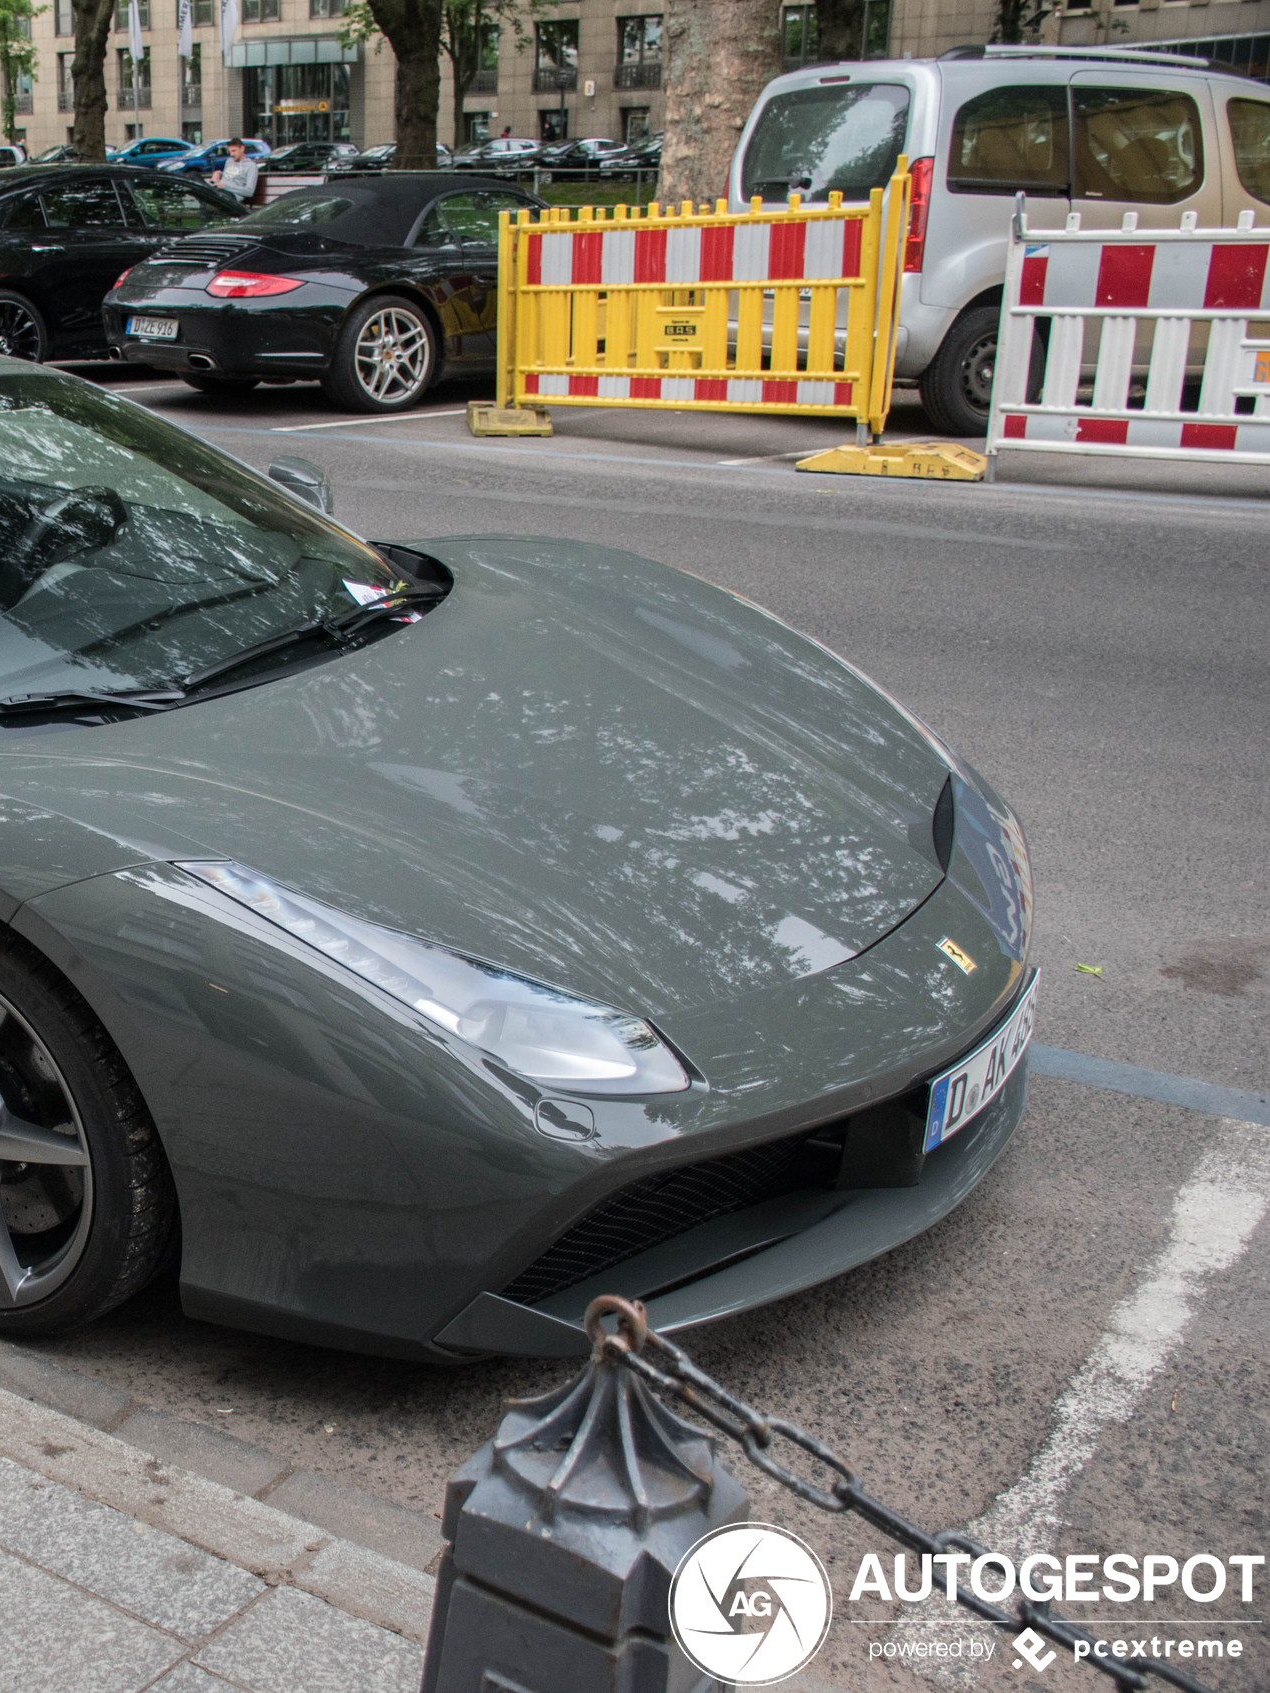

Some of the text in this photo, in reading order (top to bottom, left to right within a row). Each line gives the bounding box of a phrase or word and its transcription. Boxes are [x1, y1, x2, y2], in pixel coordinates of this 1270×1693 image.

[133, 318, 173, 336] D ZE 916
[944, 1071, 968, 1131] D
[980, 1025, 1013, 1101] AK
[932, 1121, 939, 1136] D
